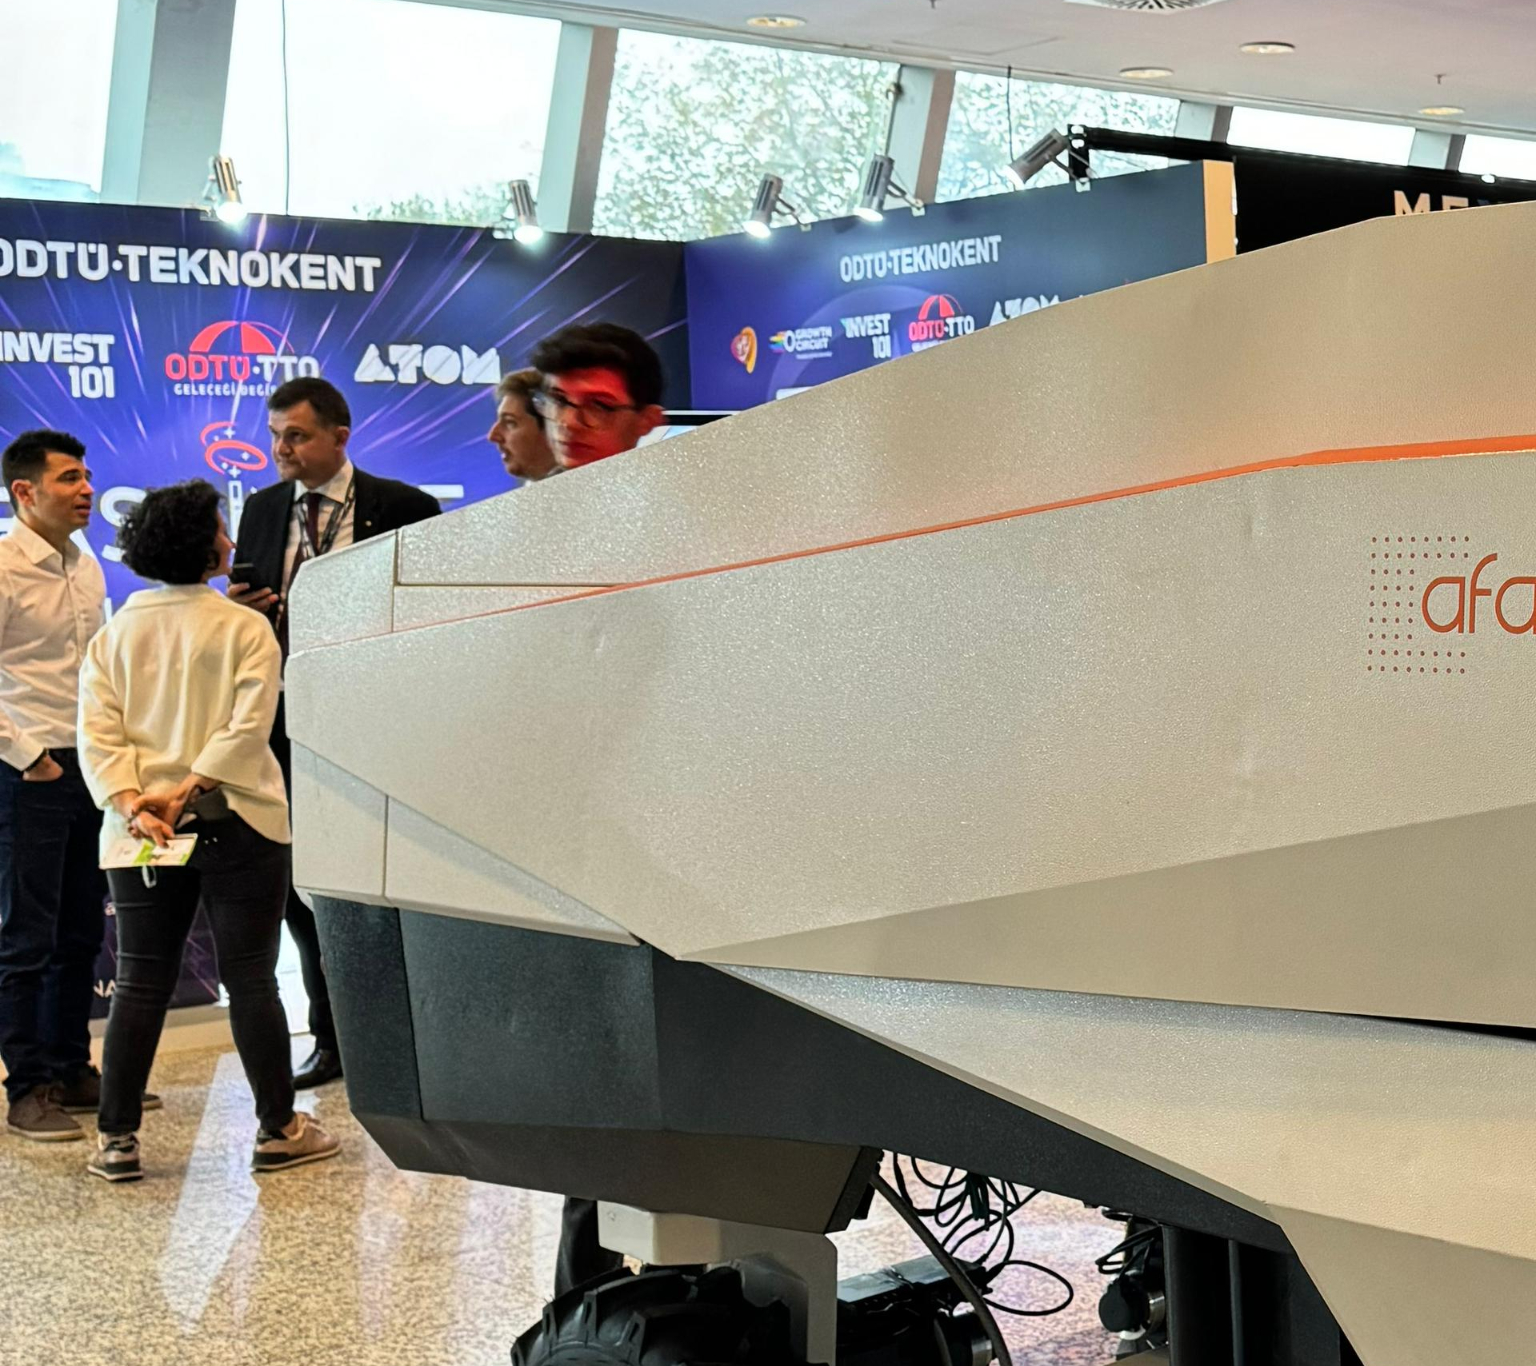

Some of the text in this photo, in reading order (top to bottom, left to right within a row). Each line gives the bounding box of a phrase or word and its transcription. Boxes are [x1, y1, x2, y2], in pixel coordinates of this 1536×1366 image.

[840, 313, 891, 338] INVEST
[871, 335, 891, 358] 101
[354, 343, 501, 386] ATOM
[68, 365, 115, 398] 101
